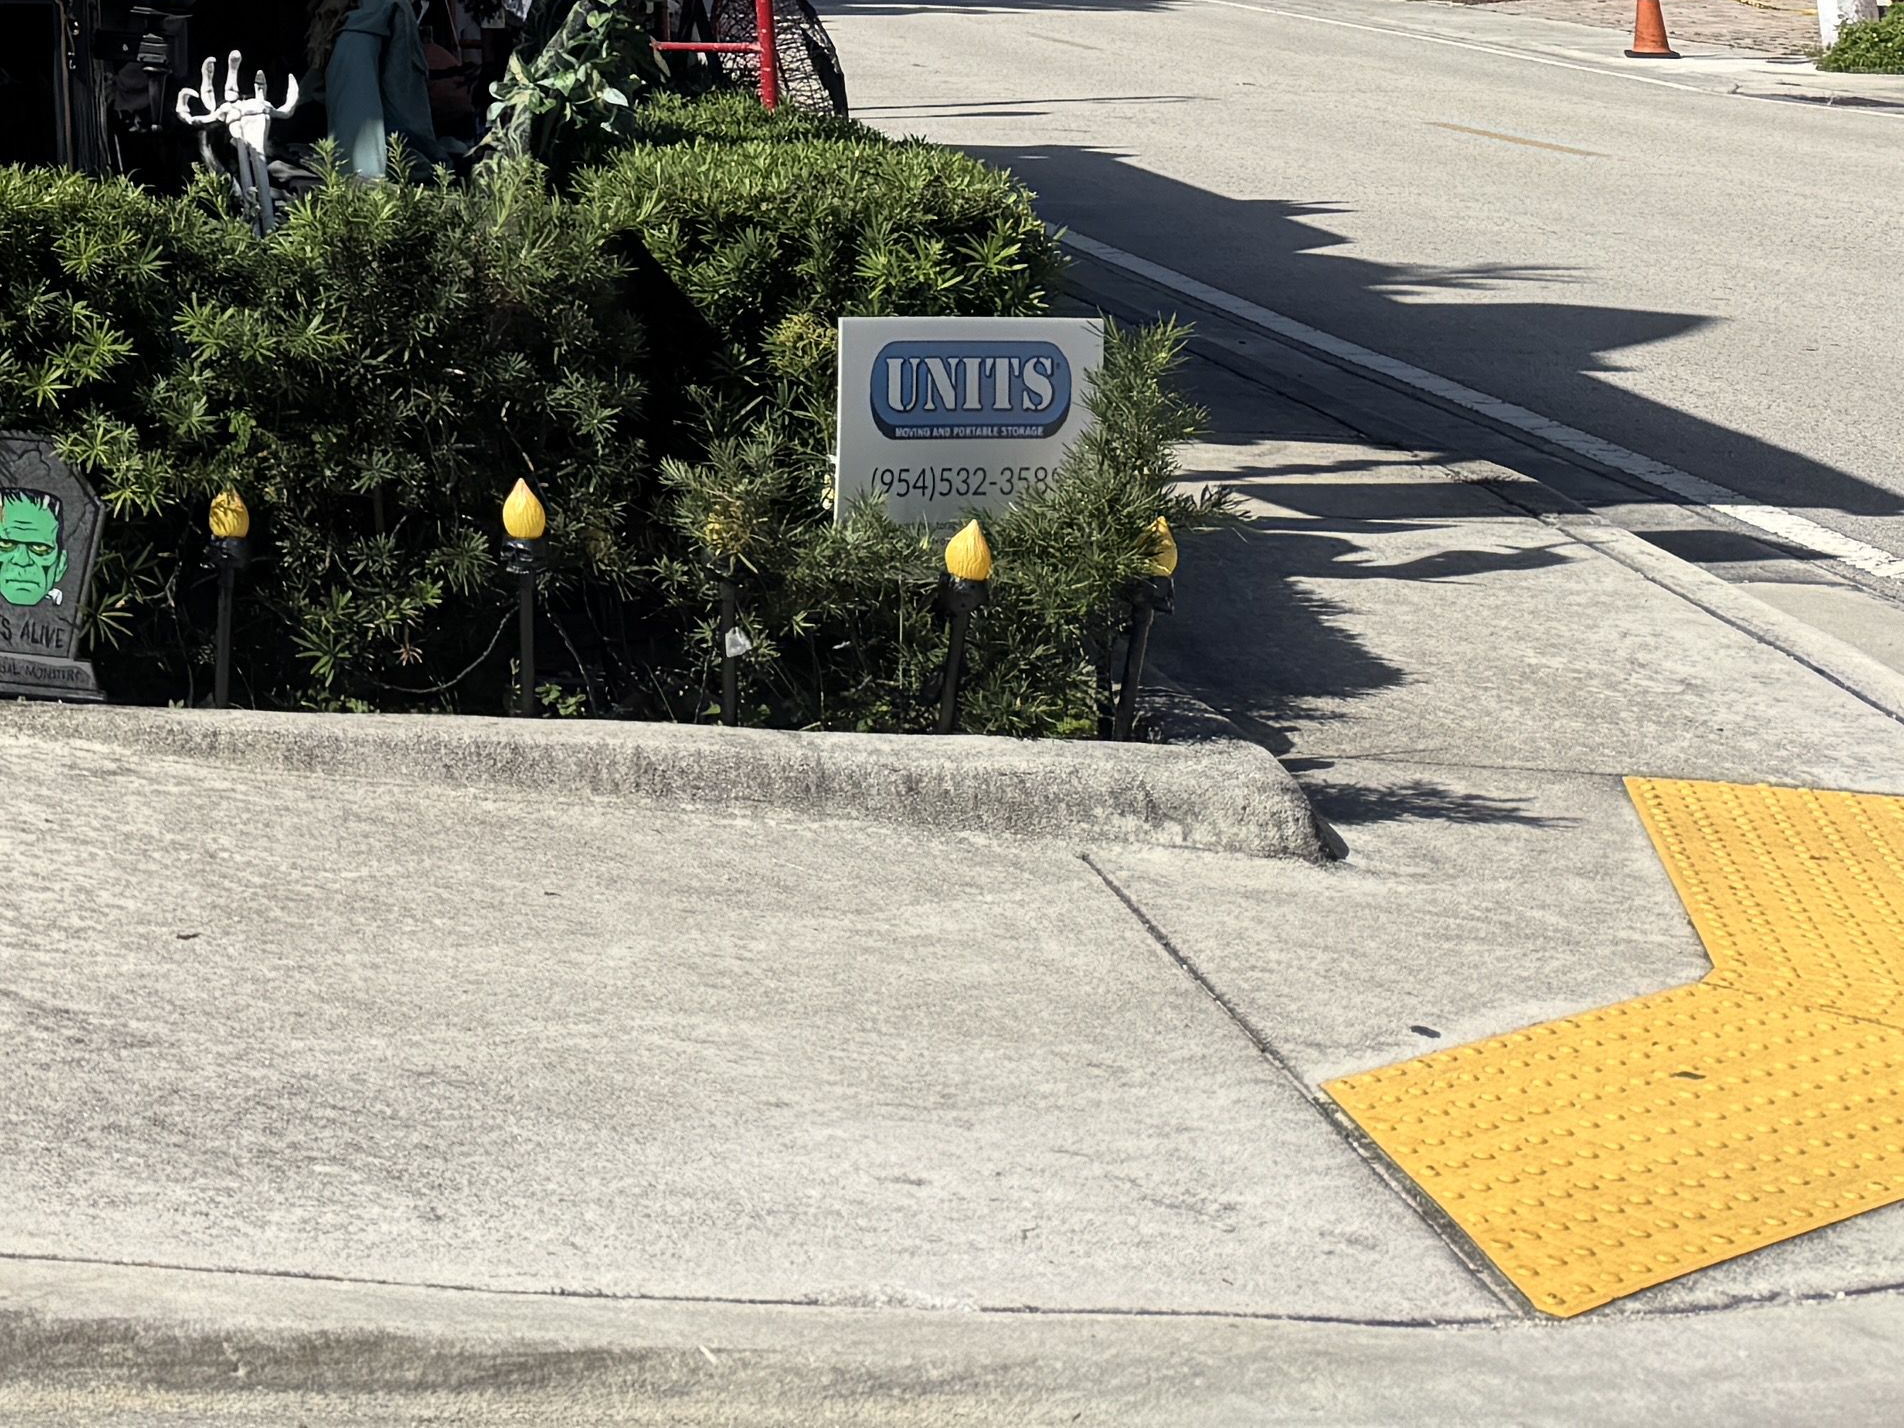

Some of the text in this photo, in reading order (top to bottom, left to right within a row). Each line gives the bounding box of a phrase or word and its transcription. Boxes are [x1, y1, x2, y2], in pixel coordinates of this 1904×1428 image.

[884, 356, 1055, 411] UNITS
[895, 425, 1045, 438] MOVING AND PORTABLE STORAGE
[20, 619, 65, 649] ALIVE
